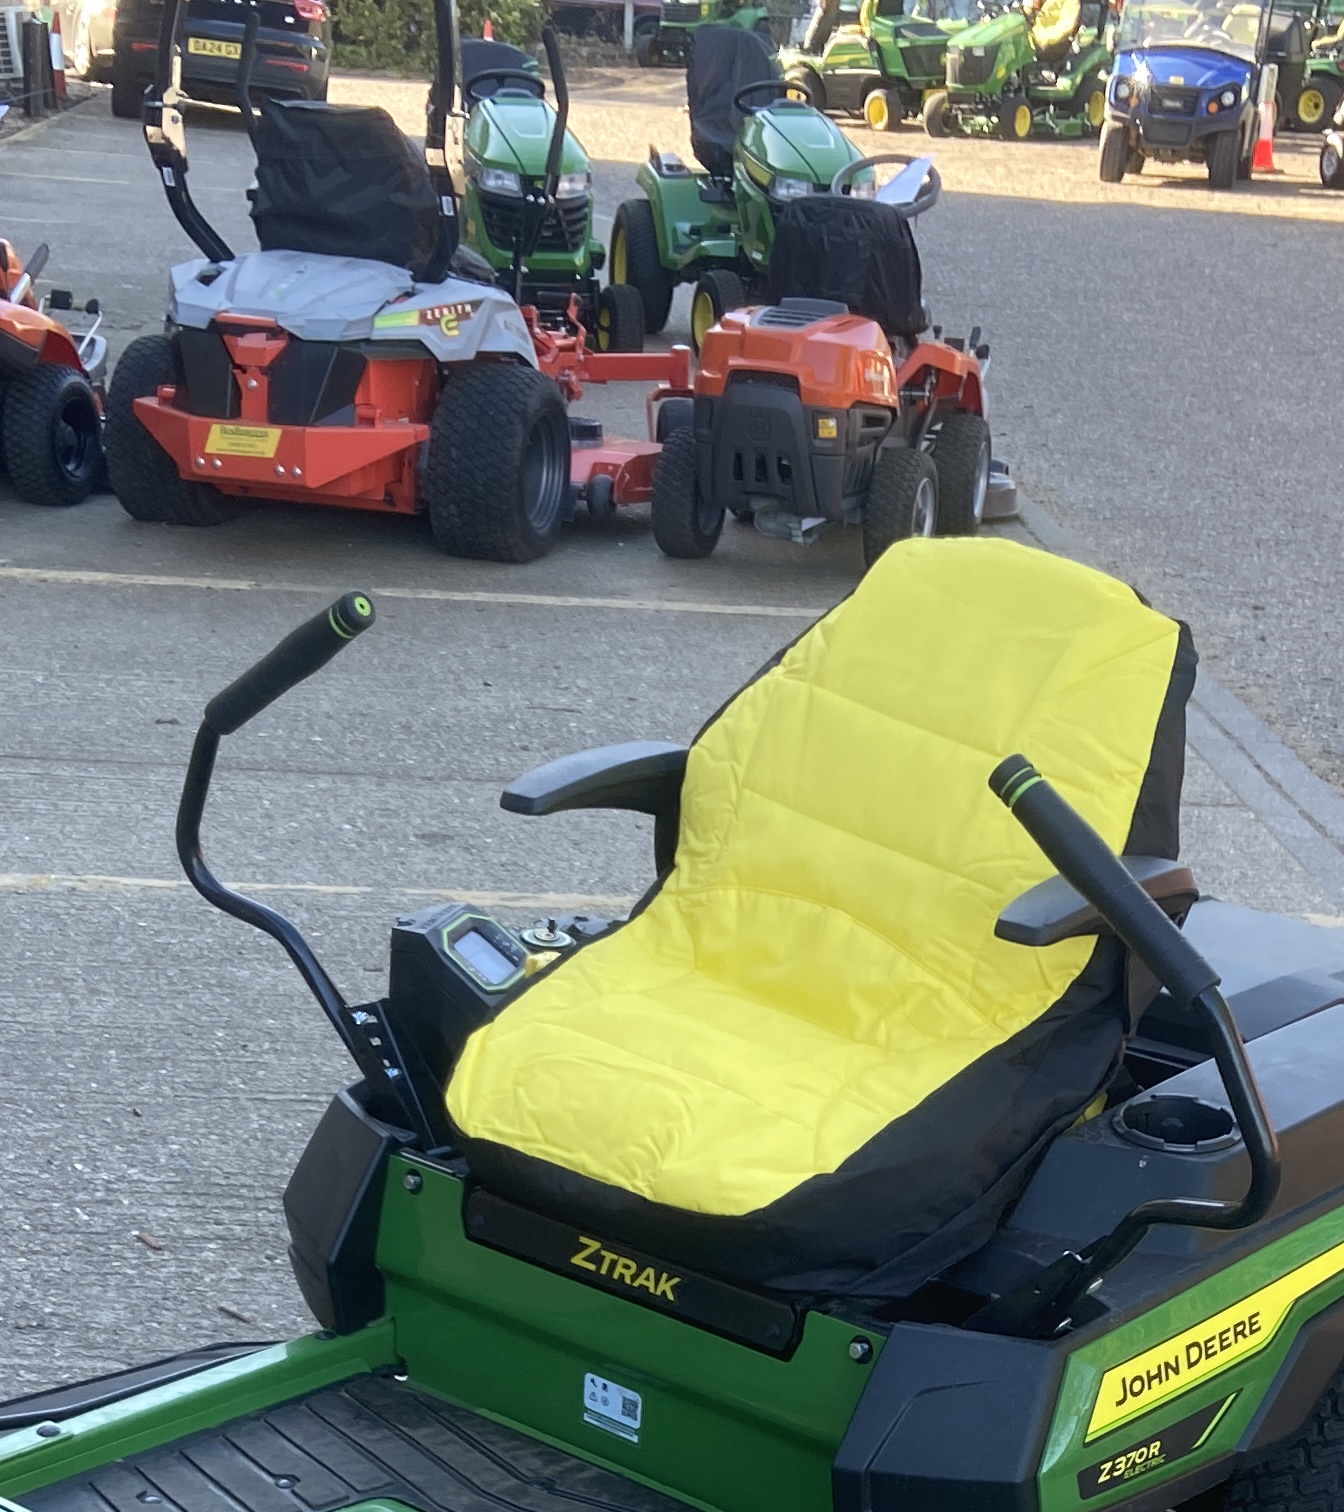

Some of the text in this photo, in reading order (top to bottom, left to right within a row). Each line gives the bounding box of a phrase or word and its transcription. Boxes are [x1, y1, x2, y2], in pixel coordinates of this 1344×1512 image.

[1115, 1311, 1262, 1408] JOHN DEERE
[1097, 1440, 1162, 1485] Z370R
